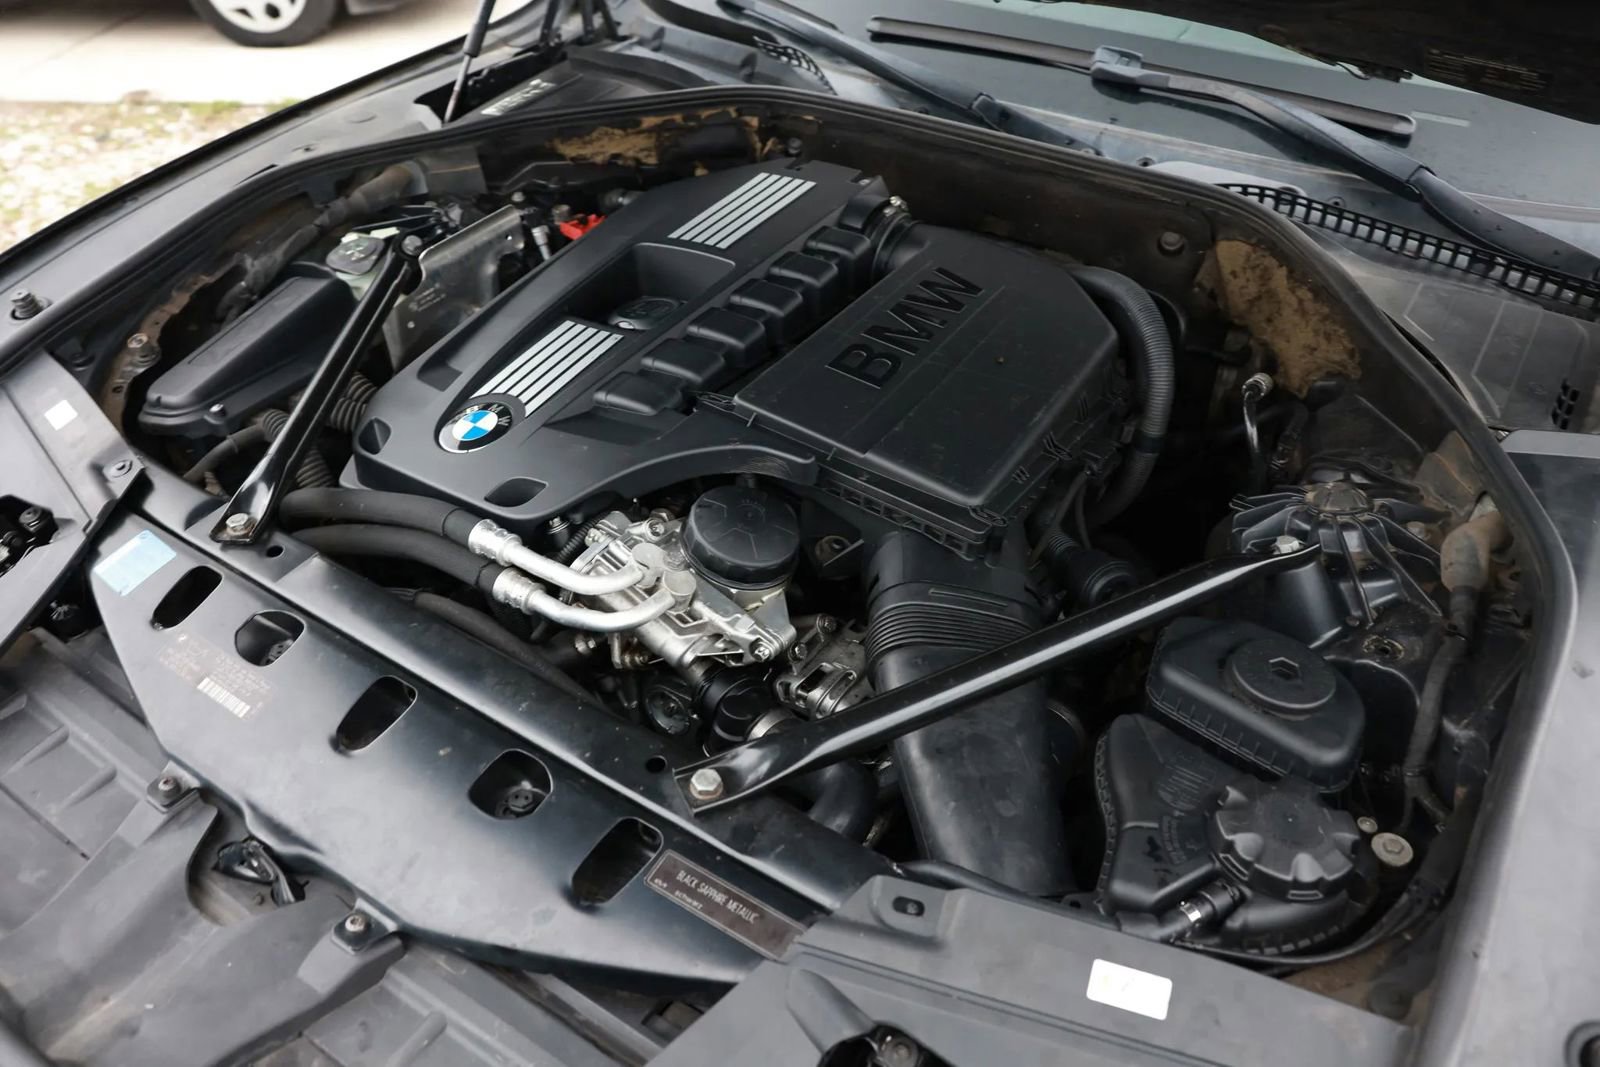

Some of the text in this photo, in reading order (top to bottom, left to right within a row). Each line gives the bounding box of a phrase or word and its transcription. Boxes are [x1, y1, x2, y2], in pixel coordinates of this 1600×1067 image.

[824, 267, 985, 390] BMW
[465, 403, 511, 426] BMW
[676, 870, 698, 888] BLACK
[698, 882, 728, 905] SAPPHIRE
[727, 899, 760, 924] METALLIC
